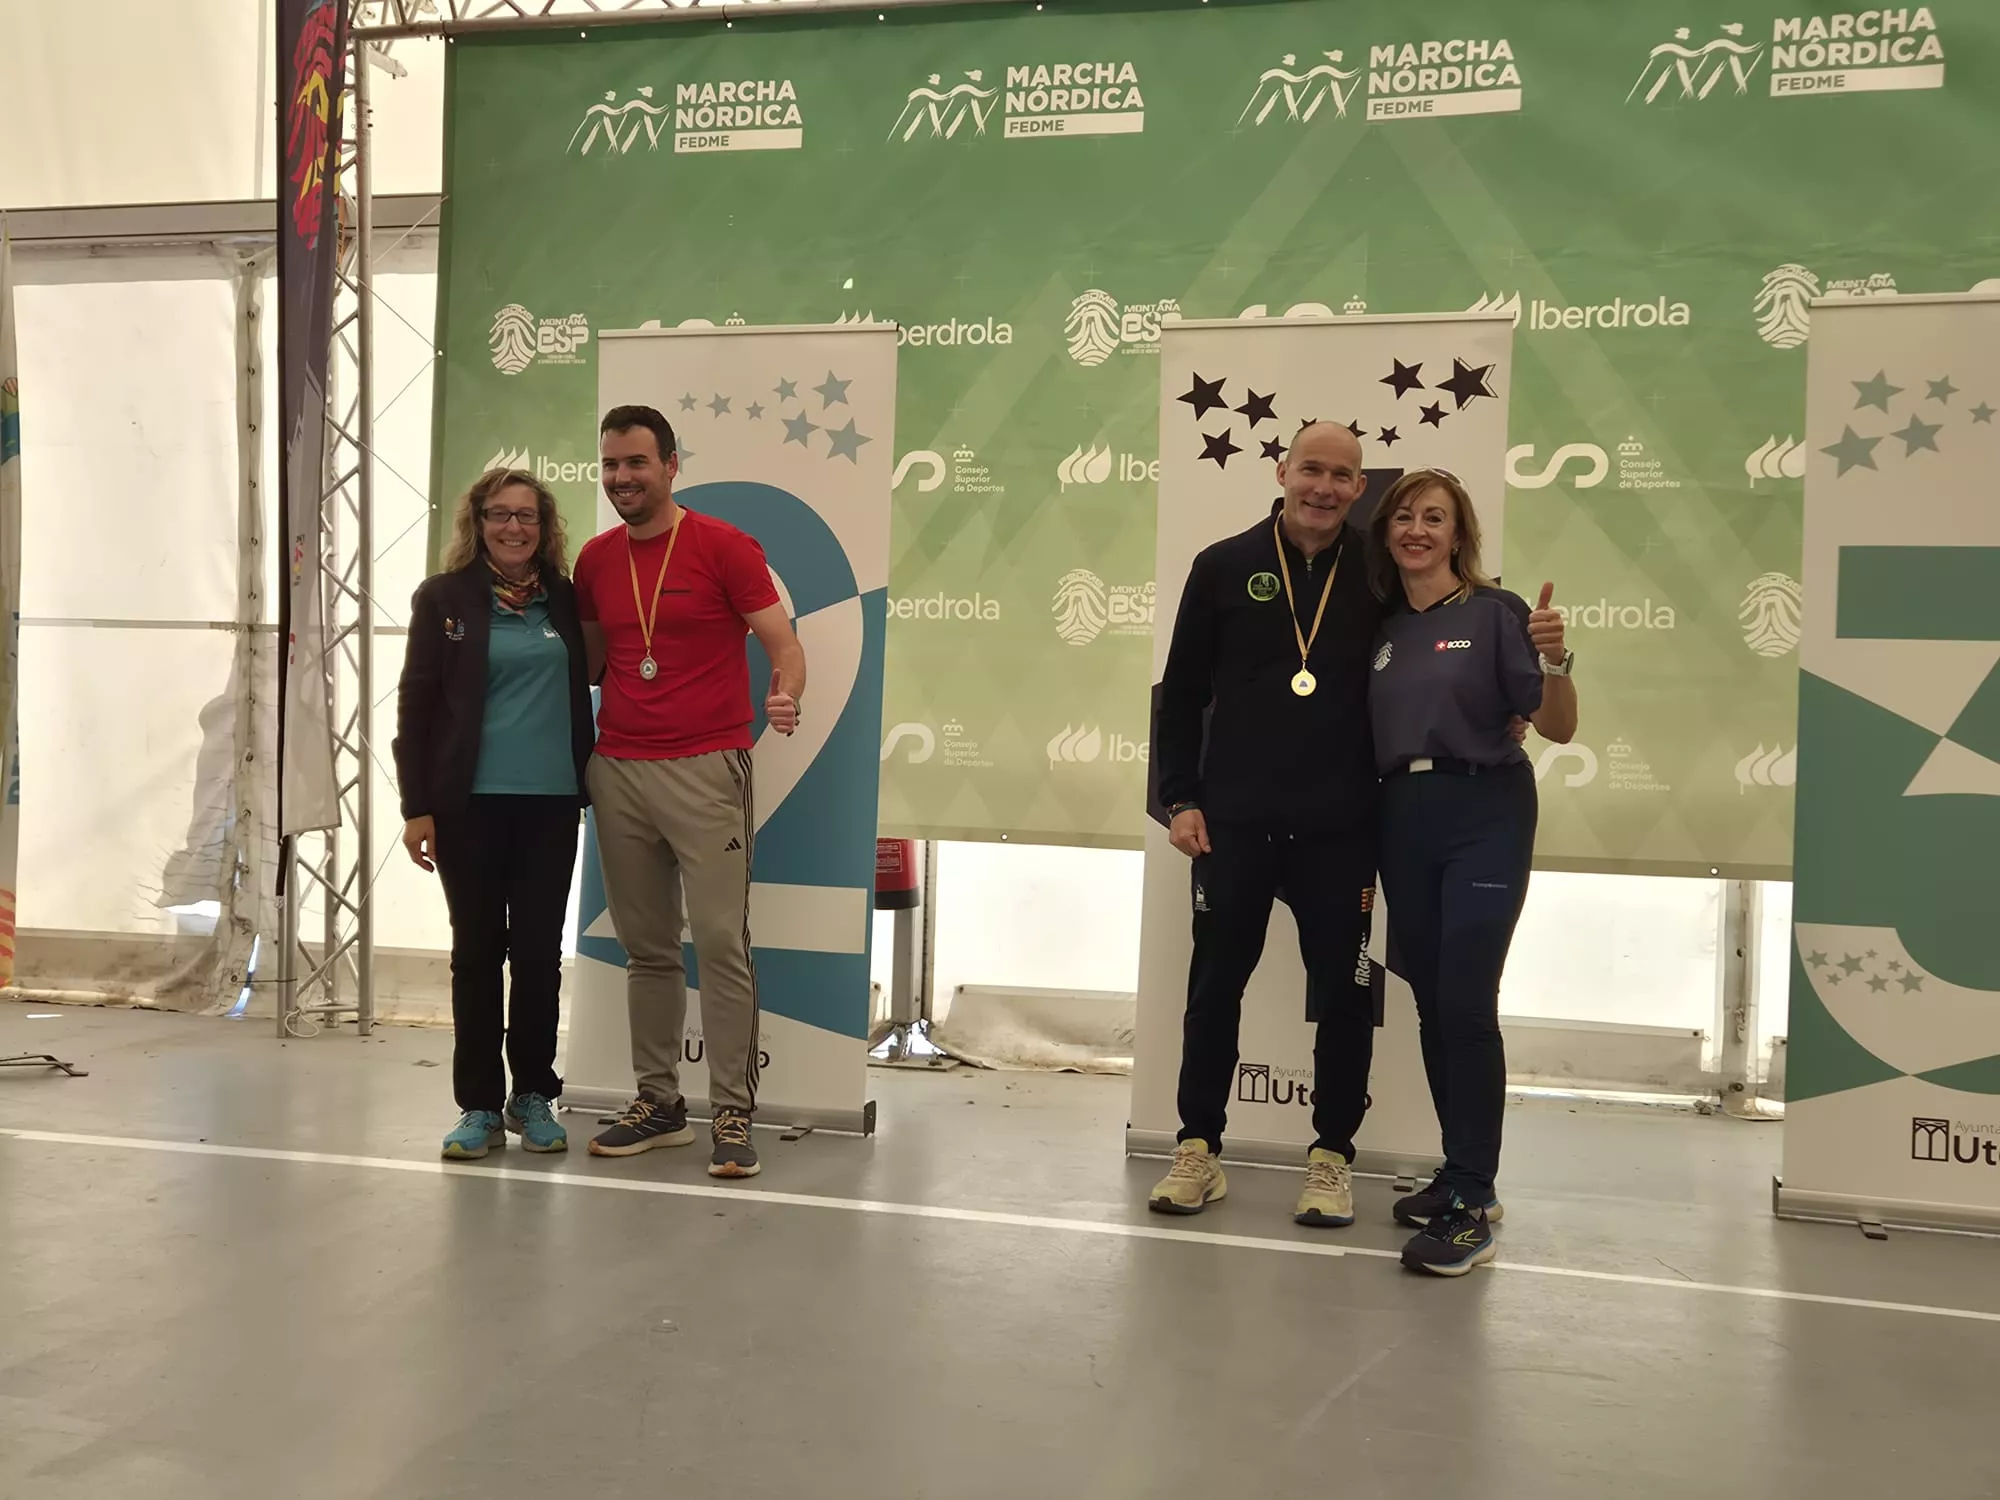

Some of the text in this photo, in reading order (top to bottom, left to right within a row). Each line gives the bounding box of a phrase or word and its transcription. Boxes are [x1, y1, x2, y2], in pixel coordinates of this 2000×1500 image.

[1773, 7, 1936, 42] MARCHA
[1369, 39, 1514, 68] MARCHA
[1772, 34, 1944, 69] NÓRDICA
[1006, 62, 1138, 88] MARCHA
[1368, 63, 1521, 94] NÓRDICA
[1777, 75, 1845, 91] FEDME
[677, 80, 796, 105] MARCHA
[1005, 84, 1144, 113] NÓRDICA
[675, 101, 803, 129] NÓRDICA
[1373, 100, 1433, 115] FEDME
[1009, 120, 1064, 133] FEDME
[679, 135, 730, 148] FEDME
[1529, 296, 1690, 330] Iberdrola
